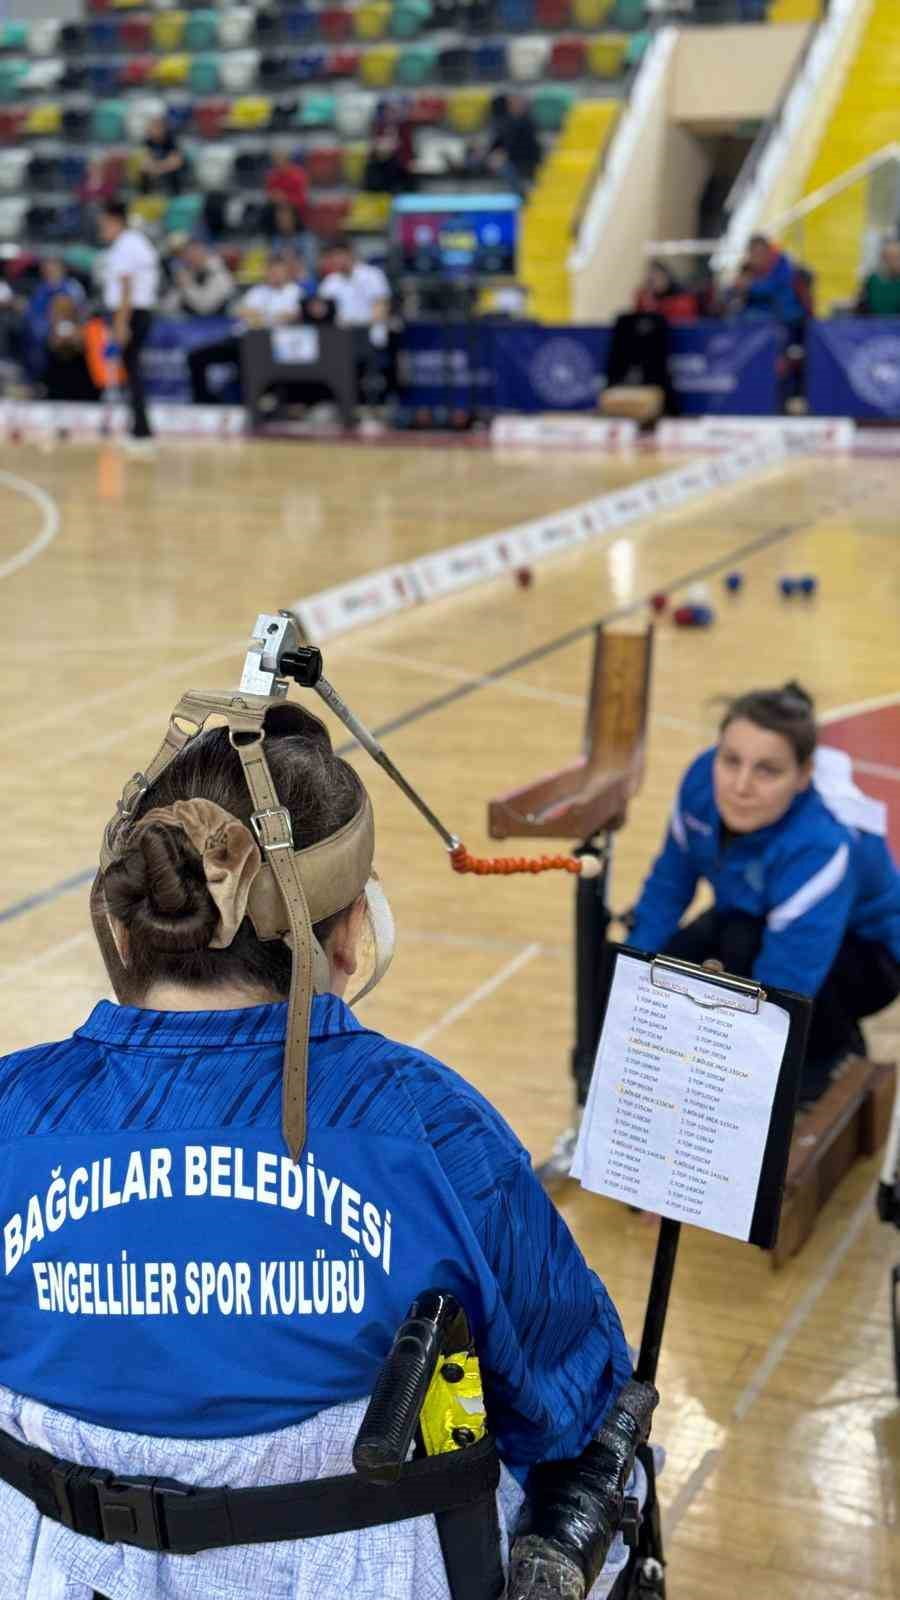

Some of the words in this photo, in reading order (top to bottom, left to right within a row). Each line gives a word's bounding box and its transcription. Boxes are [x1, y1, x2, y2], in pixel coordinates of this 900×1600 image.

[3, 1147, 172, 1275] BAĞCILAR
[184, 1145, 392, 1275] BELEDİYESİ
[32, 1250, 178, 1315] ENGELLİLER
[185, 1261, 253, 1315] SPOR
[260, 1249, 365, 1315] KULÜBÜ
